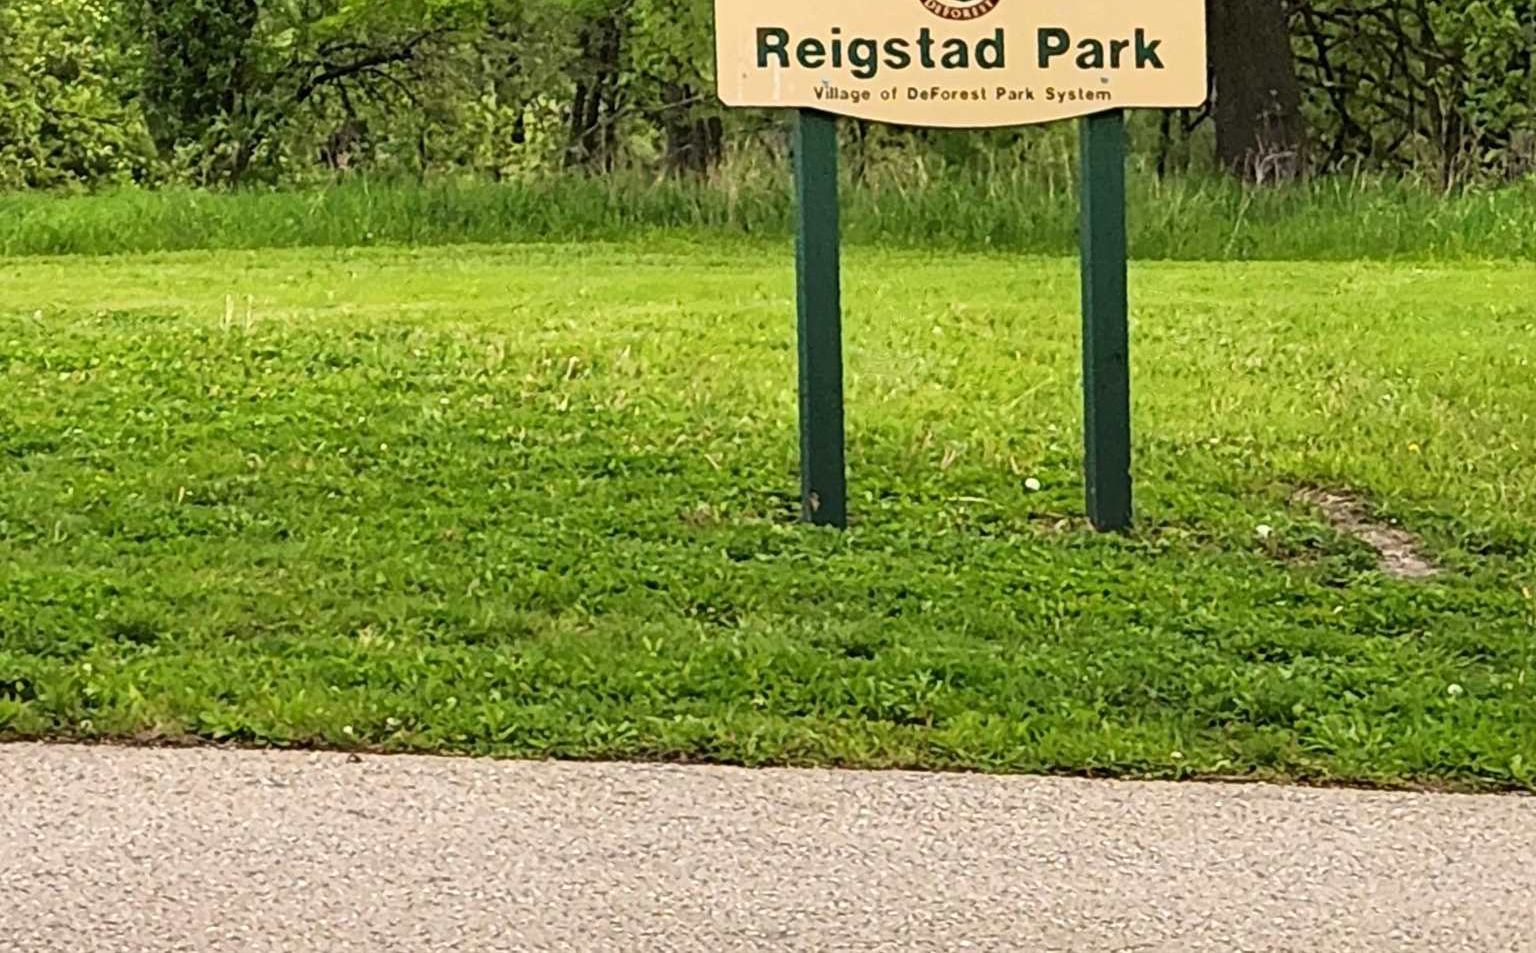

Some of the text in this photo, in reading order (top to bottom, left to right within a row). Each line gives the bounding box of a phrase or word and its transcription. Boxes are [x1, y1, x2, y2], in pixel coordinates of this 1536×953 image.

[755, 27, 1165, 79] Reigstad Park
[813, 86, 1112, 103] Village of DeForest Park System
